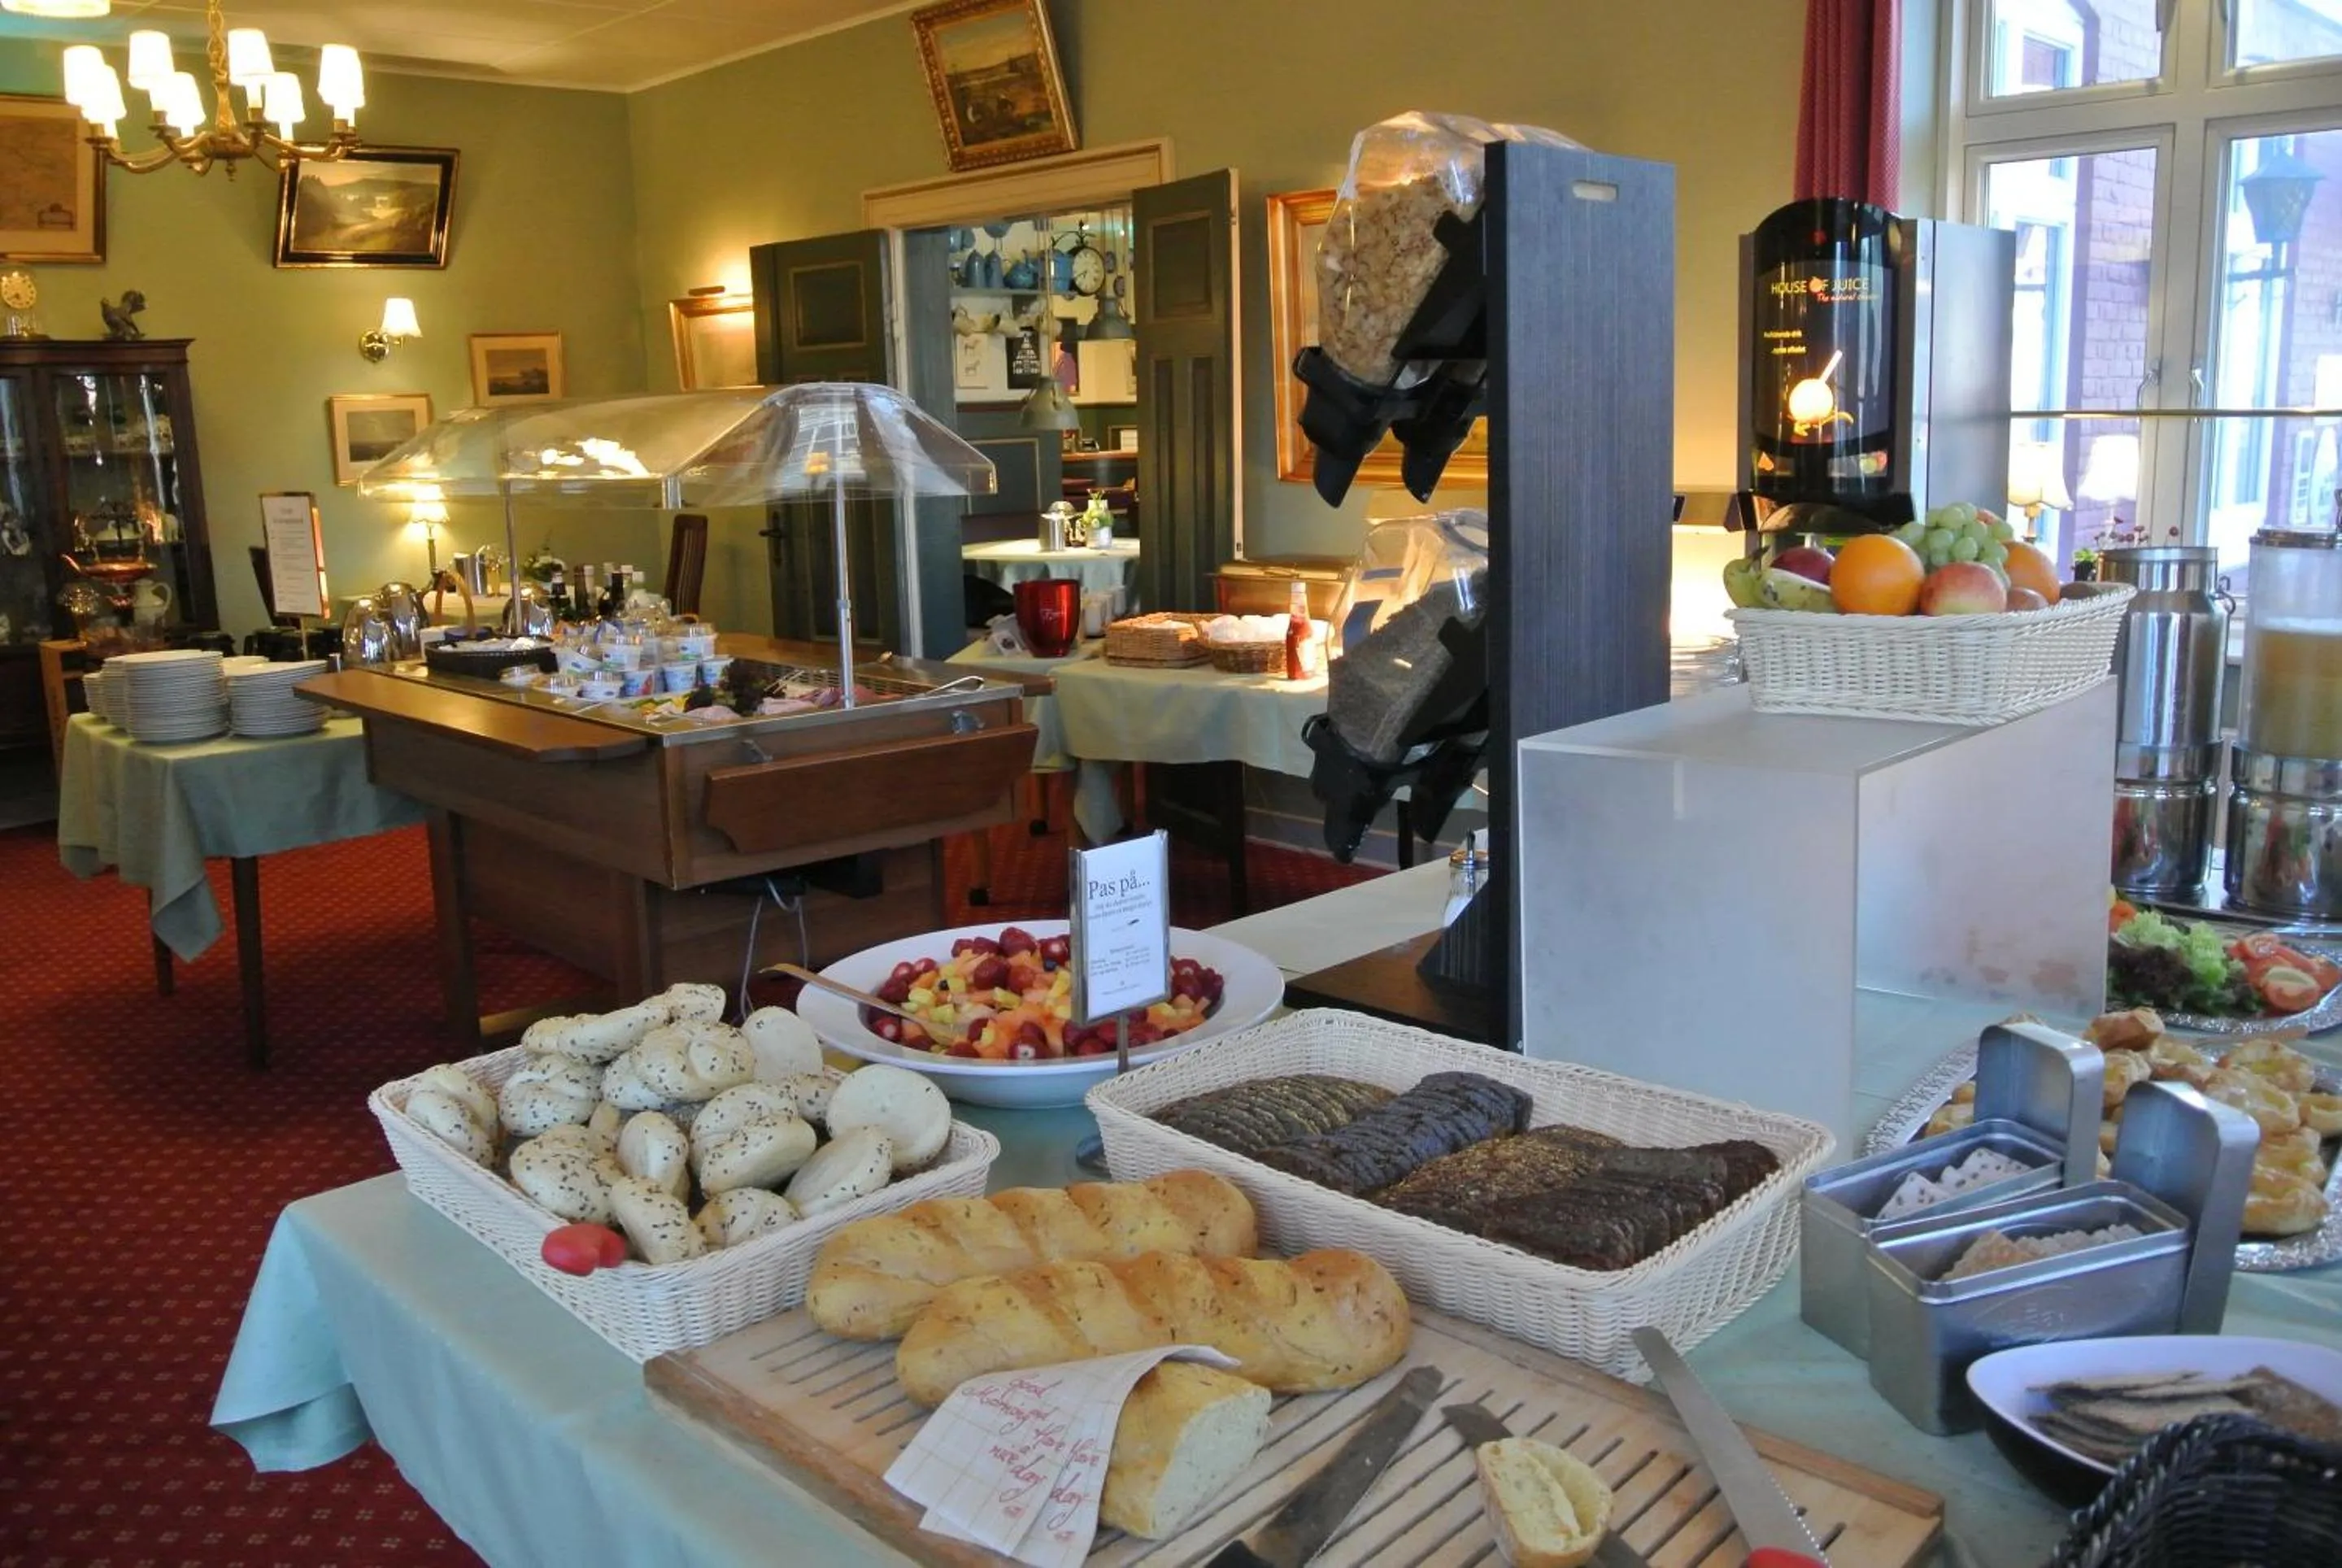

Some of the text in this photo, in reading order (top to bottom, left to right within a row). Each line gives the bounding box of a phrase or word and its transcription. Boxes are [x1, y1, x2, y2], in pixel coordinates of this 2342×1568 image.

[1771, 281, 1807, 294] HOUSE
[1832, 277, 1870, 292] JUICE
[1089, 880, 1115, 900] Pas
